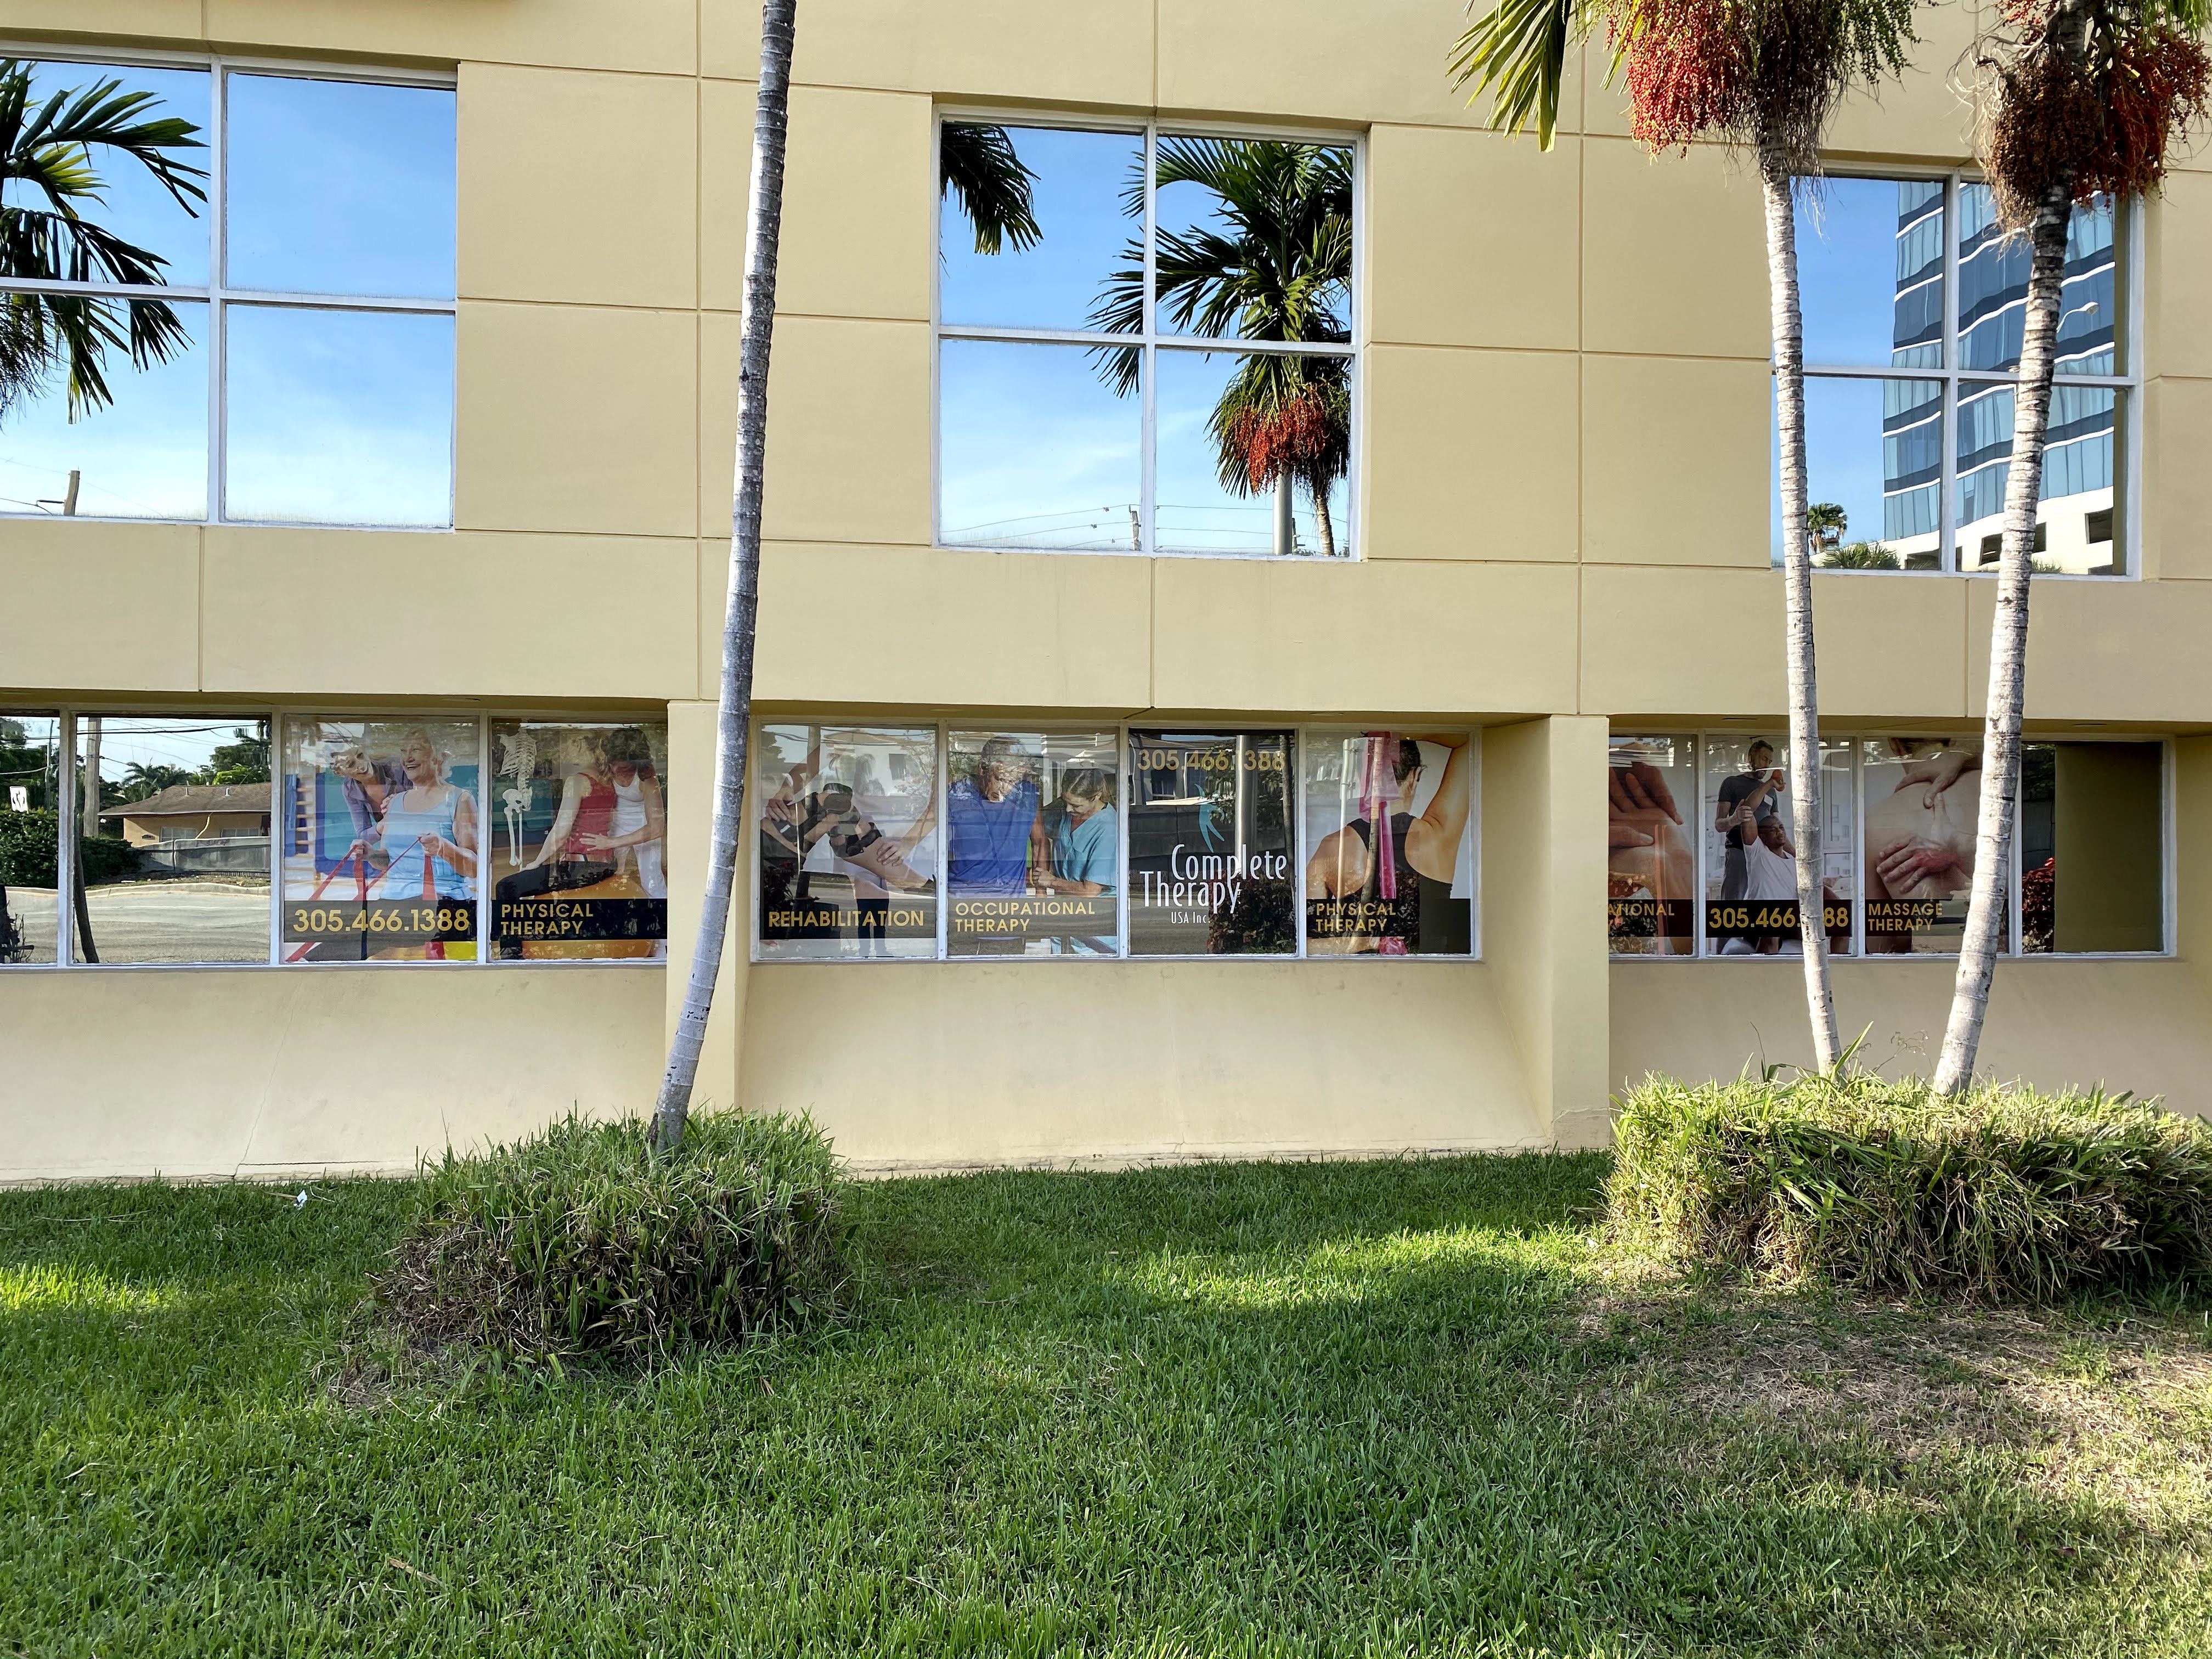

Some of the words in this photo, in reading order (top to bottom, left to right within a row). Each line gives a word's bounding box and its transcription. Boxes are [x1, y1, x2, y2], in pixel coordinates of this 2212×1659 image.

[1137, 749, 1285, 770] 305.466.388
[1171, 844, 1287, 881] Complete
[1139, 871, 1241, 914] Therapy
[501, 904, 594, 918] PHYSICAL
[955, 901, 1095, 916] OCCUPATIONAL
[1316, 902, 1396, 916] PHYSICAL
[1868, 903, 1943, 916] MASSAGE
[292, 909, 470, 932] 305.466.1388
[769, 910, 924, 927] REHABILITATION
[1171, 912, 1189, 924] USA
[1193, 912, 1210, 924] Inc.
[1709, 907, 1849, 928] 305.466.88
[1867, 918, 1933, 931] THERAPY
[500, 921, 584, 935] THERAPY
[955, 918, 1030, 932] THERAPY
[1316, 918, 1387, 932] THERAPY
